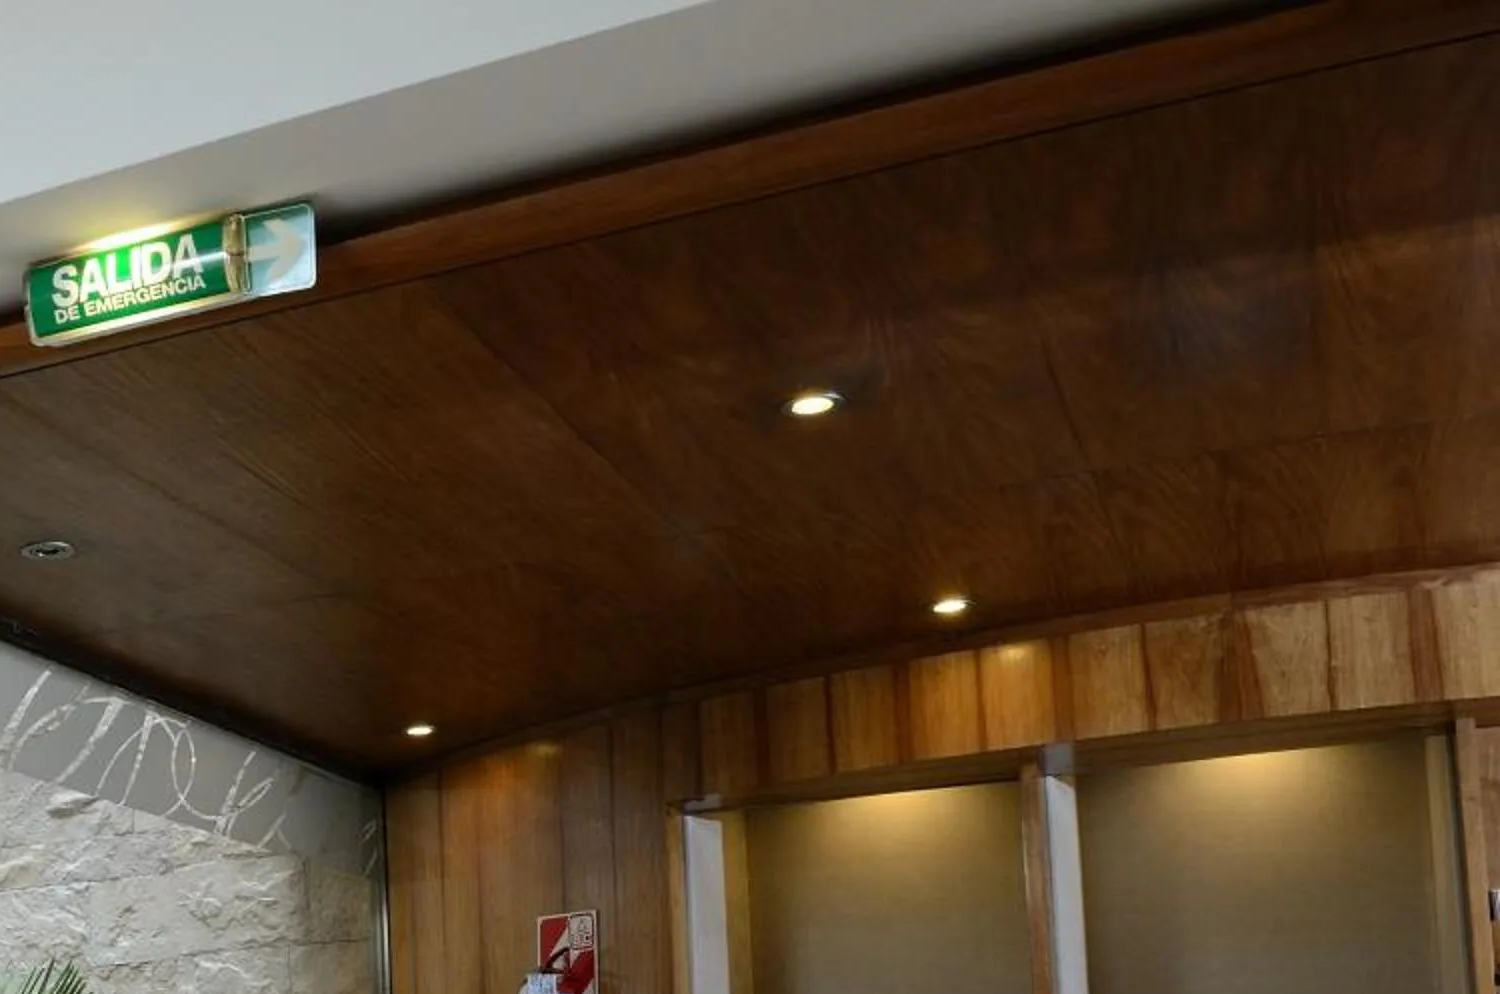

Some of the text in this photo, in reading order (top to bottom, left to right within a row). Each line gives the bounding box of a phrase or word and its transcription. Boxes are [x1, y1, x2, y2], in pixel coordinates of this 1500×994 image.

[52, 233, 205, 308] SALIDA
[54, 274, 207, 325] DE EMERGENCIA
